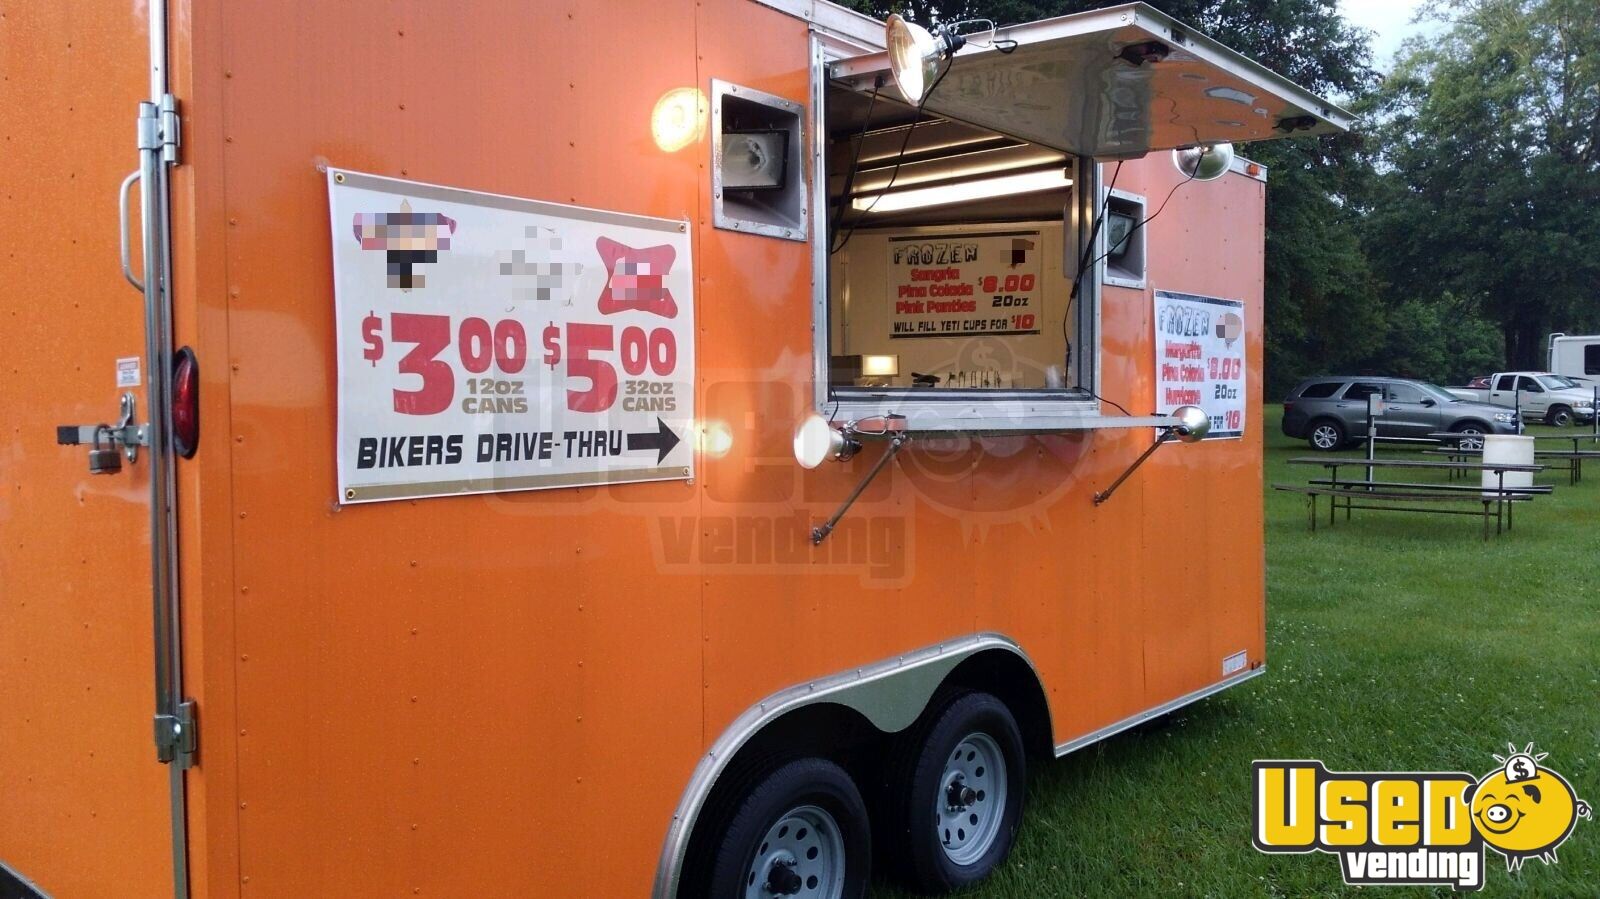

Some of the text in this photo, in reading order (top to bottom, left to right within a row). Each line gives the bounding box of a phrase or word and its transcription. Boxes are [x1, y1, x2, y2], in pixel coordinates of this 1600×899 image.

[894, 242, 979, 265] FROZEN
[911, 267, 960, 282] Sangria
[898, 283, 973, 298] Pina Colada
[896, 299, 976, 314] Pink Panties
[894, 314, 1035, 332] WILL FILL YETI CUPS FOR $10
[1159, 305, 1210, 336] FROZEN
[462, 397, 528, 414] CANS
[622, 397, 676, 412] CANS
[357, 435, 463, 469] BIKERS
[476, 430, 623, 463] DRIVE-THRU
